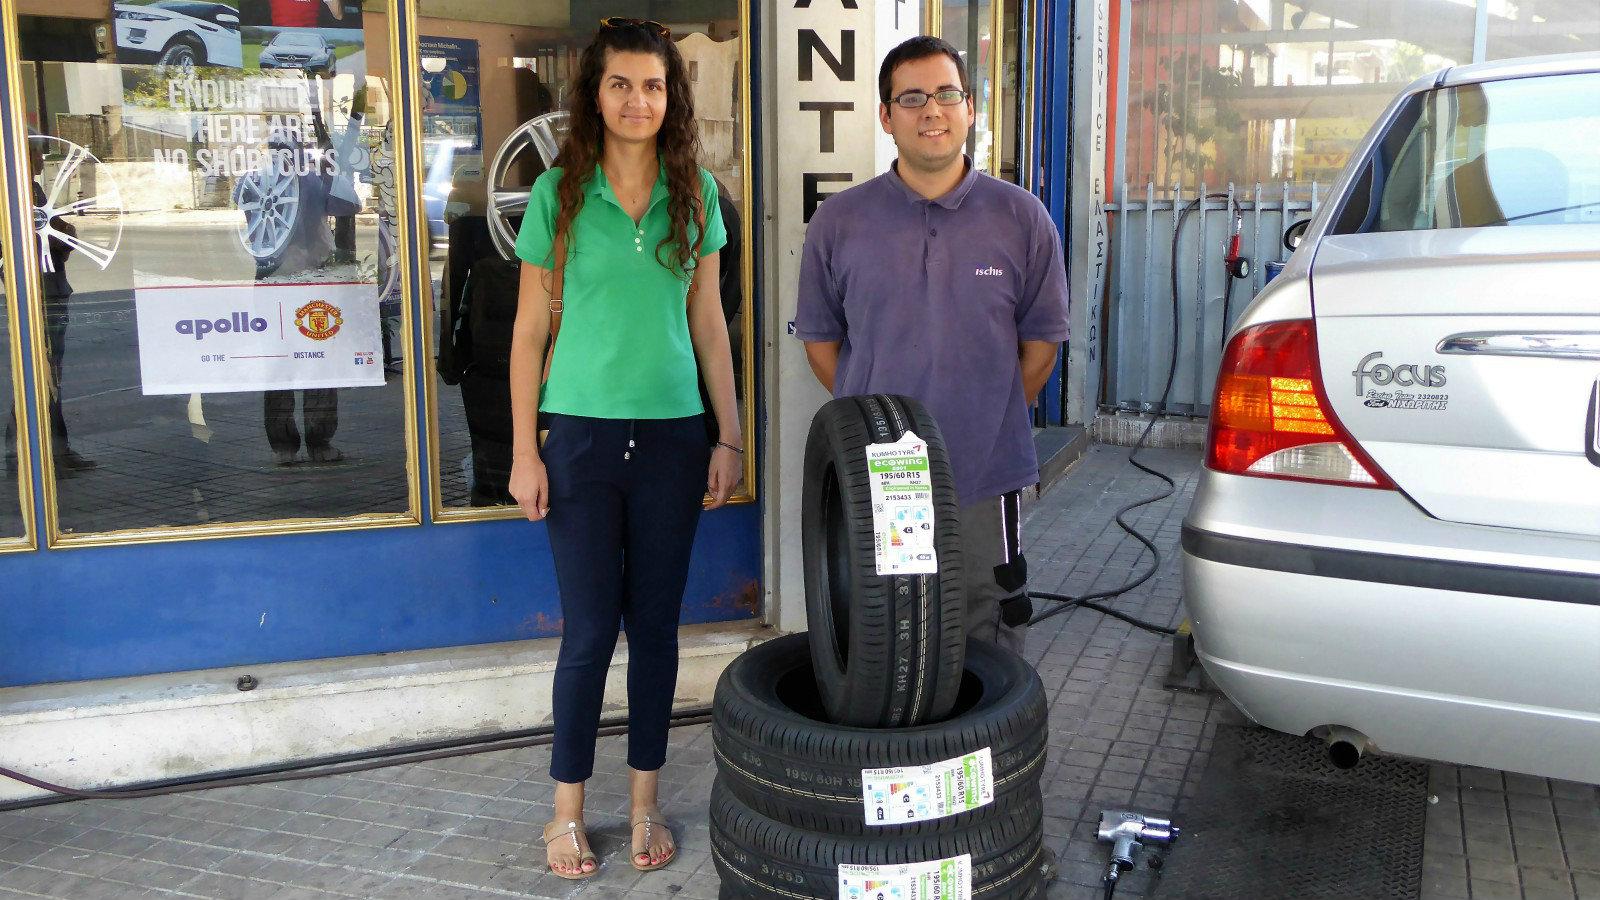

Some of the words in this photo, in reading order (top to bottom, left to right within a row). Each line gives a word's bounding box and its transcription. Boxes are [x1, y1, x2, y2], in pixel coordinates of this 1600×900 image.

[1096, 3, 1104, 151] SERVICE
[185, 114, 261, 143] THERE
[269, 114, 317, 143] ARE
[153, 149, 188, 175] NO
[1089, 178, 1104, 362] ΕΛΑΣΤΙΚΩΝ
[175, 312, 268, 341] apollo
[201, 355, 211, 363] GO
[213, 354, 226, 362] THE
[880, 472, 905, 480] 195/60
[907, 471, 920, 479] R15
[956, 766, 964, 792] 195/60
